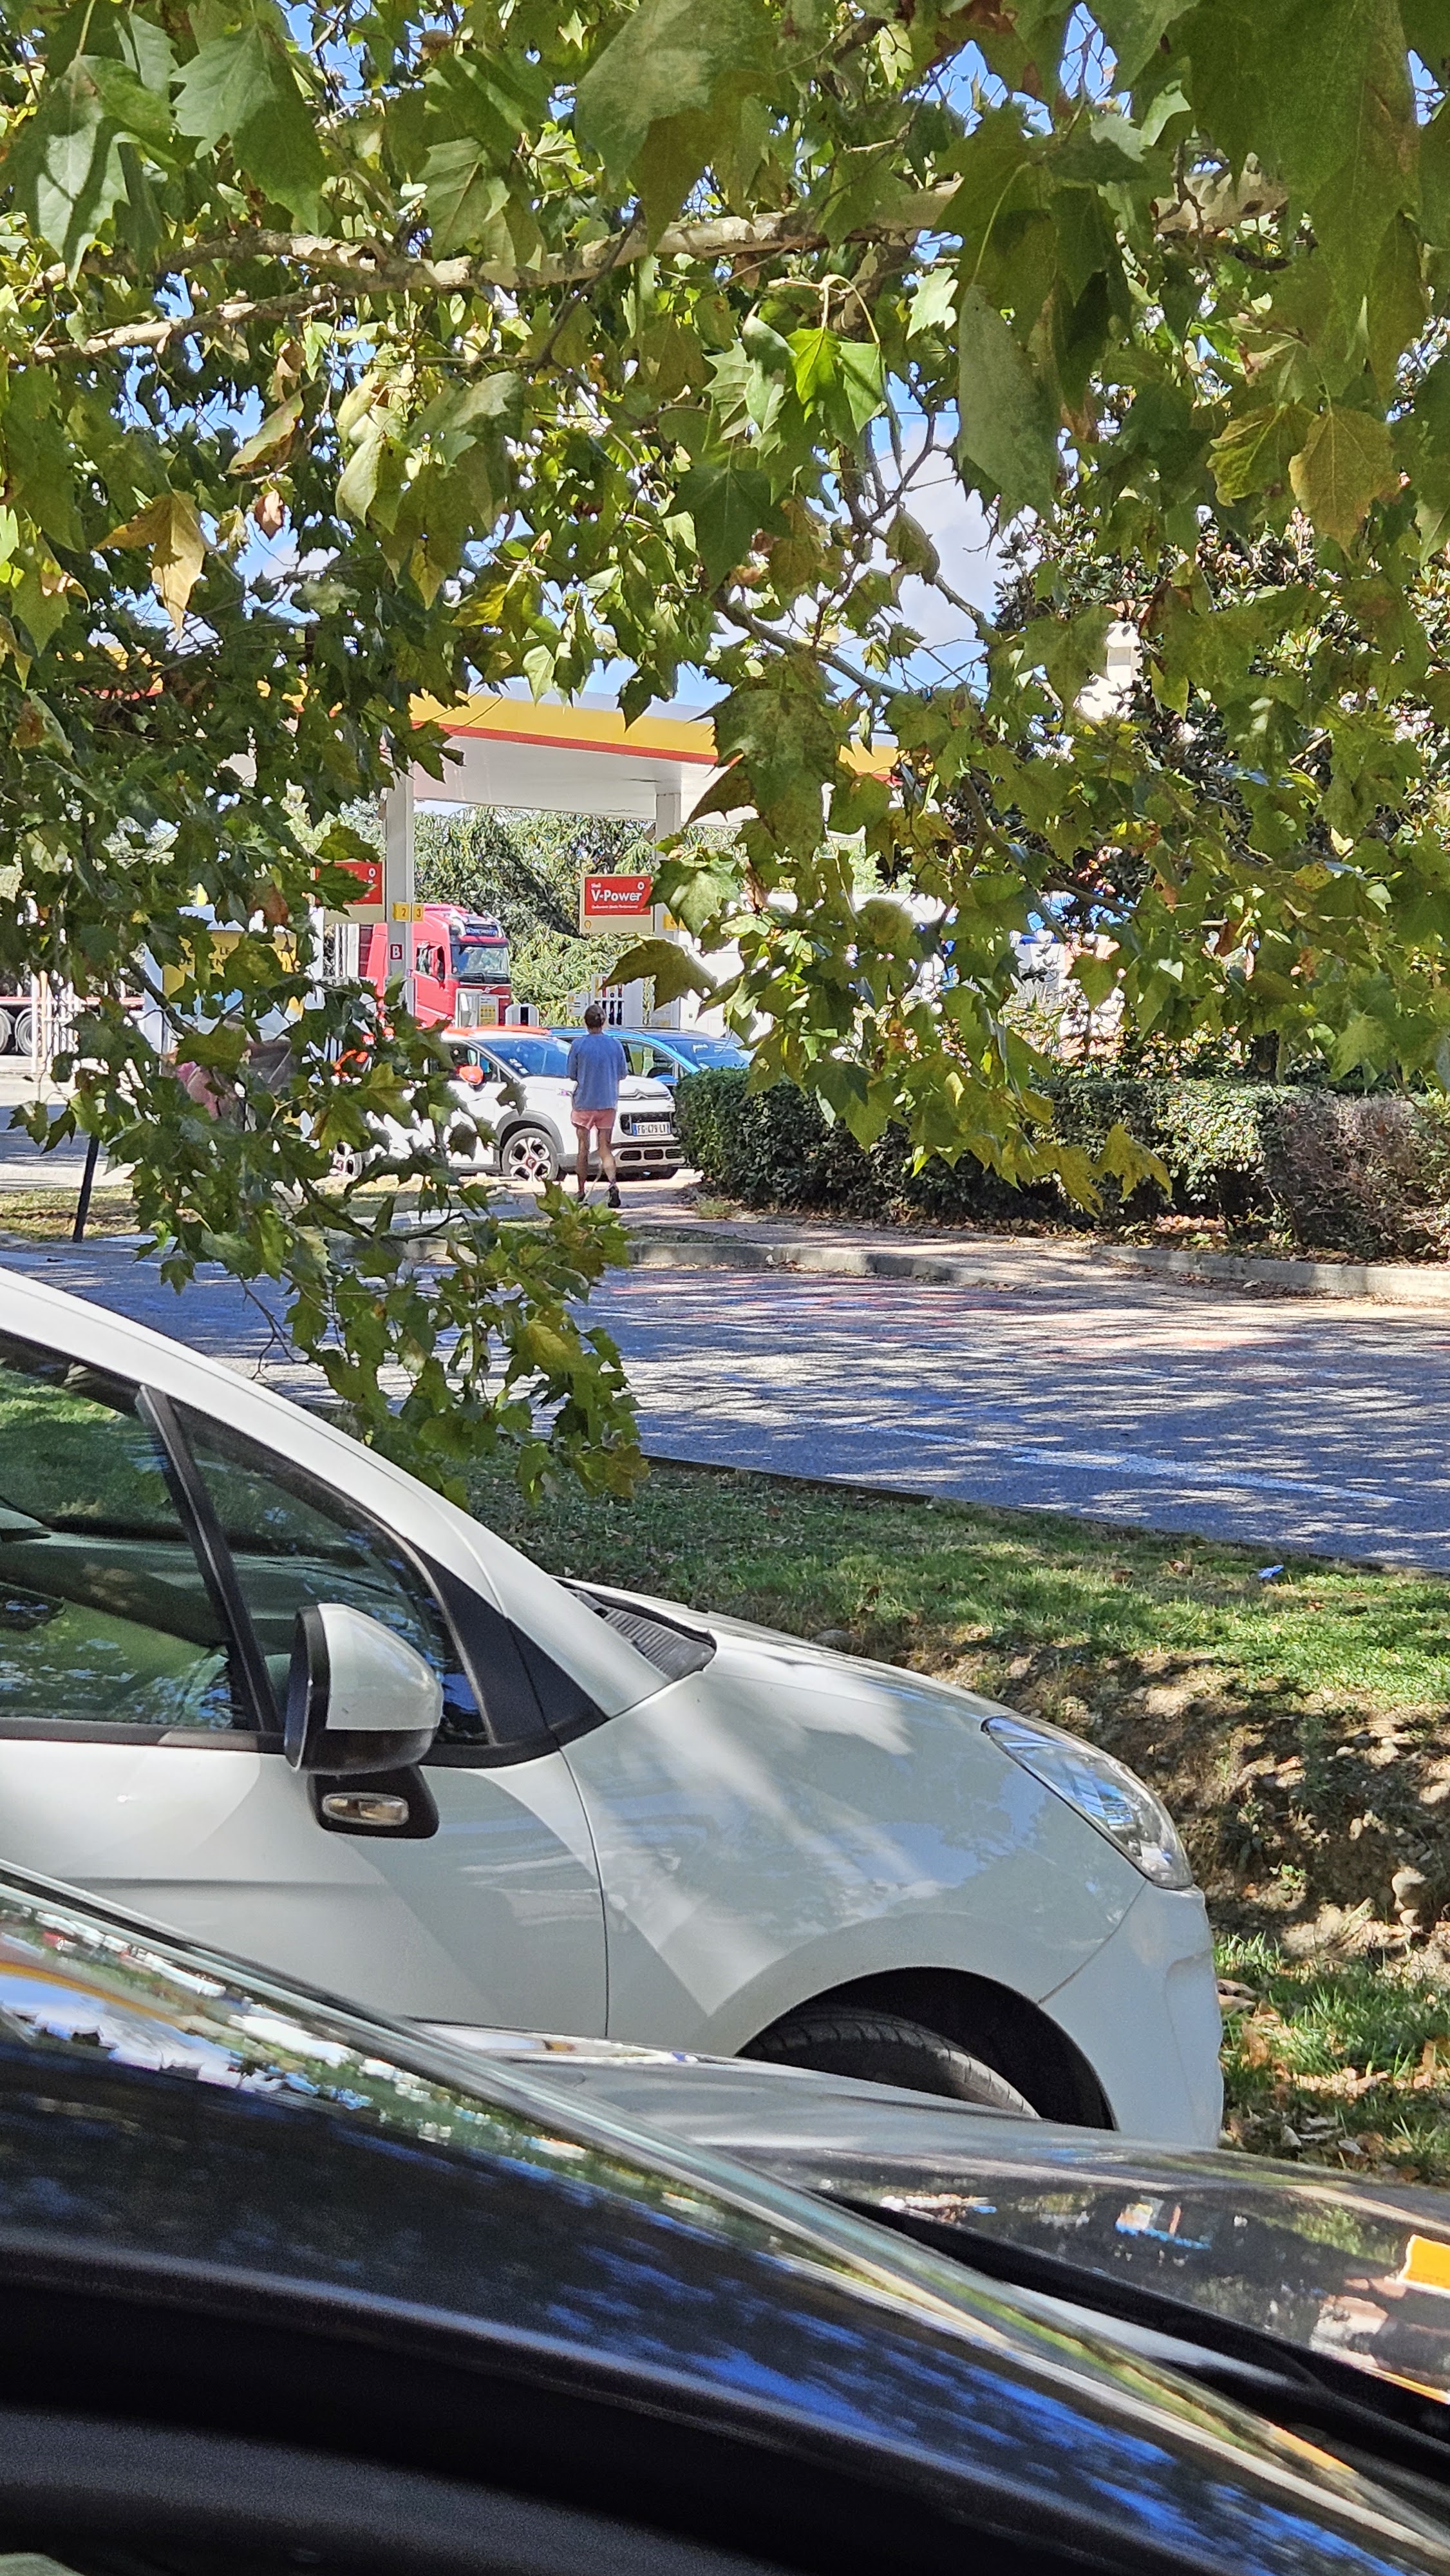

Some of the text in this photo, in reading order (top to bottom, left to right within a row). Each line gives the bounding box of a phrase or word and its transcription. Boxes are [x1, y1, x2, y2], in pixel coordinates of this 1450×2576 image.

[591, 889, 643, 902] V-Power
[401, 908, 406, 917] 2
[416, 908, 422, 918] 3
[392, 945, 400, 958] B
